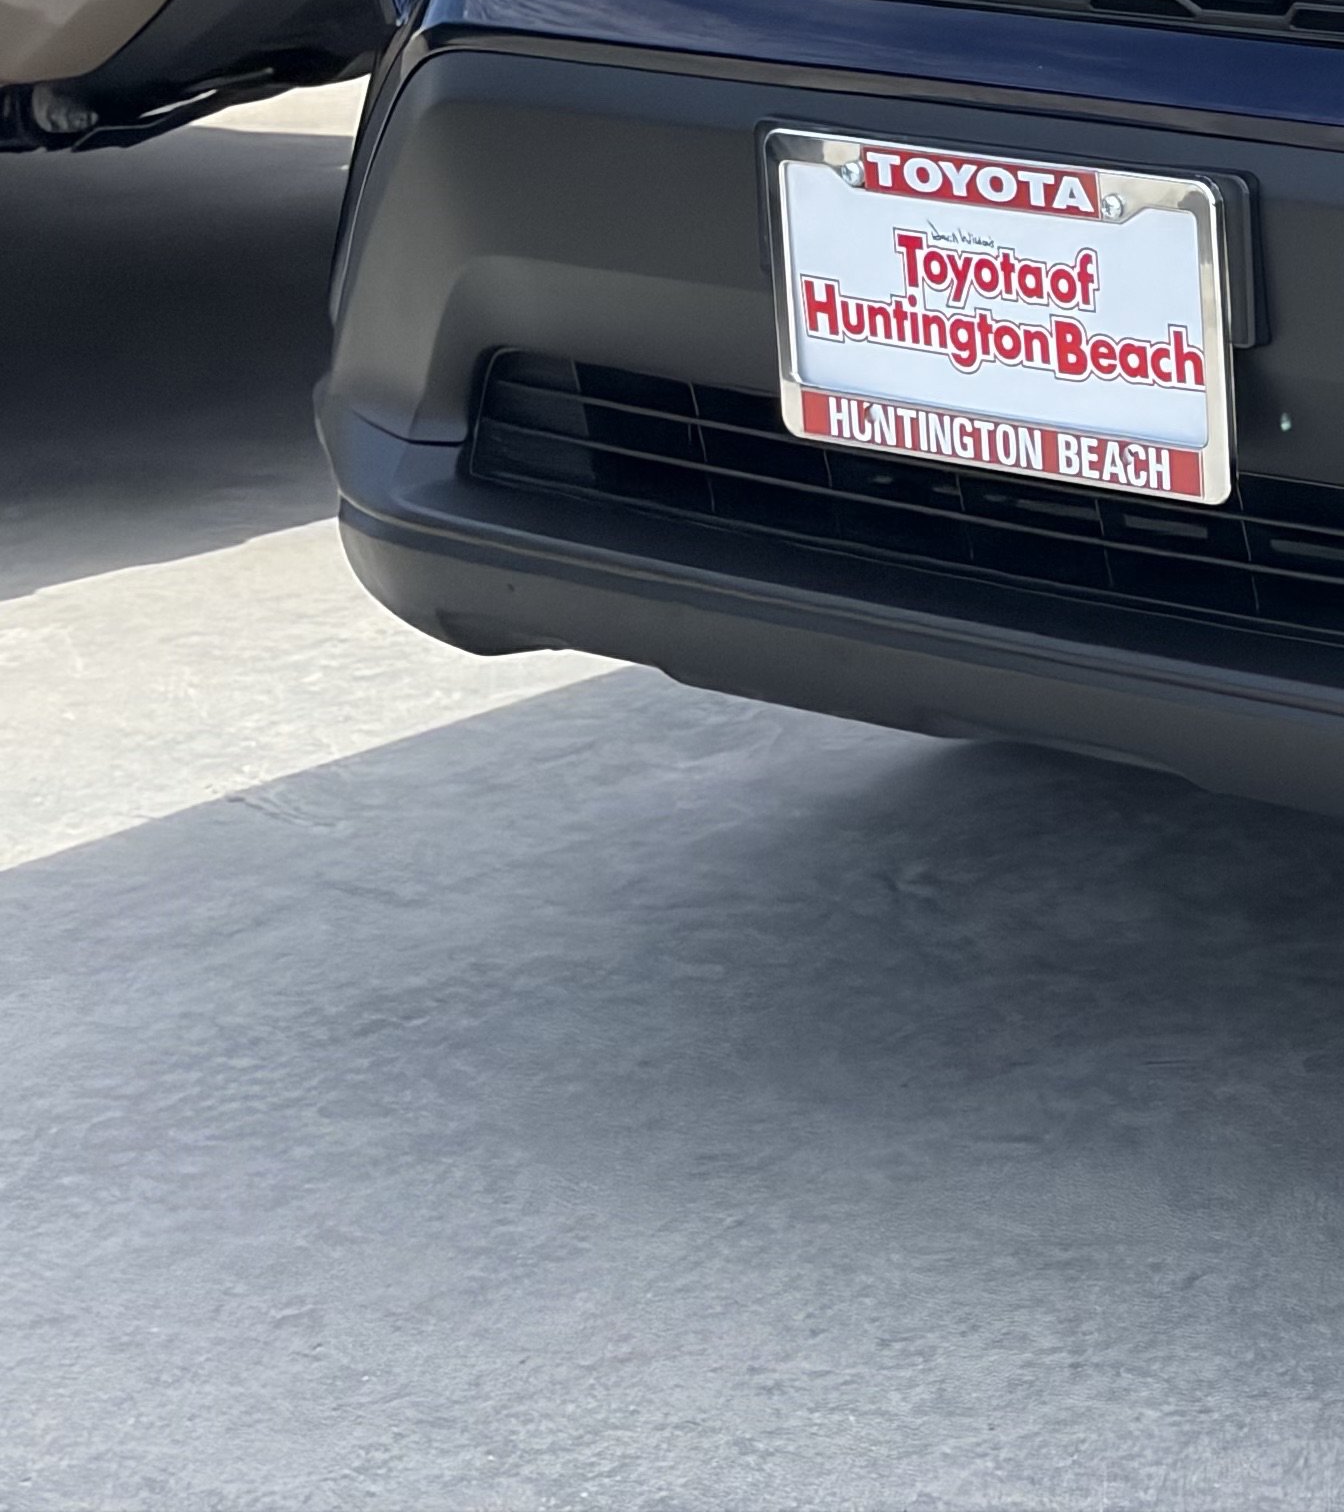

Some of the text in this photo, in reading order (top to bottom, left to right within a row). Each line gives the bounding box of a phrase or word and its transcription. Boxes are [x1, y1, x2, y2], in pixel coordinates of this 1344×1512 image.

[865, 152, 1094, 214] TOYOTA
[894, 233, 1096, 306] Toyota of
[802, 279, 1205, 386] Huntington Beach
[827, 397, 1172, 491] HUNTINGTON BEACH
